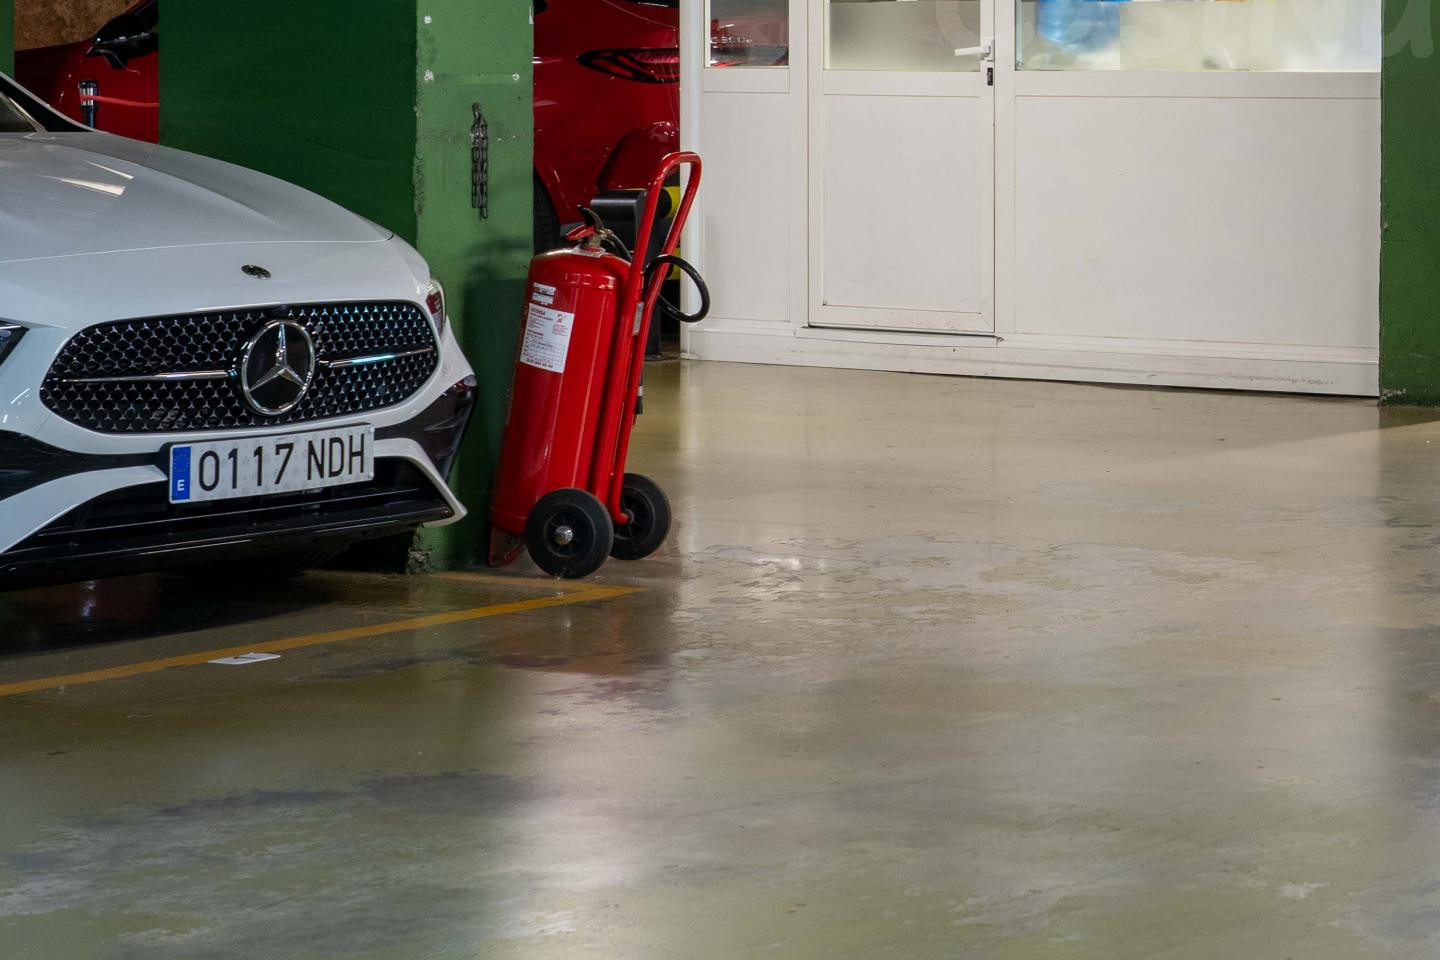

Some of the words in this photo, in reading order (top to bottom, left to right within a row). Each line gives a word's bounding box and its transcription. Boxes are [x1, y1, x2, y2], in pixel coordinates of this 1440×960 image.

[198, 442, 295, 491] 0117
[307, 433, 366, 481] NDH
[176, 479, 185, 491] E
